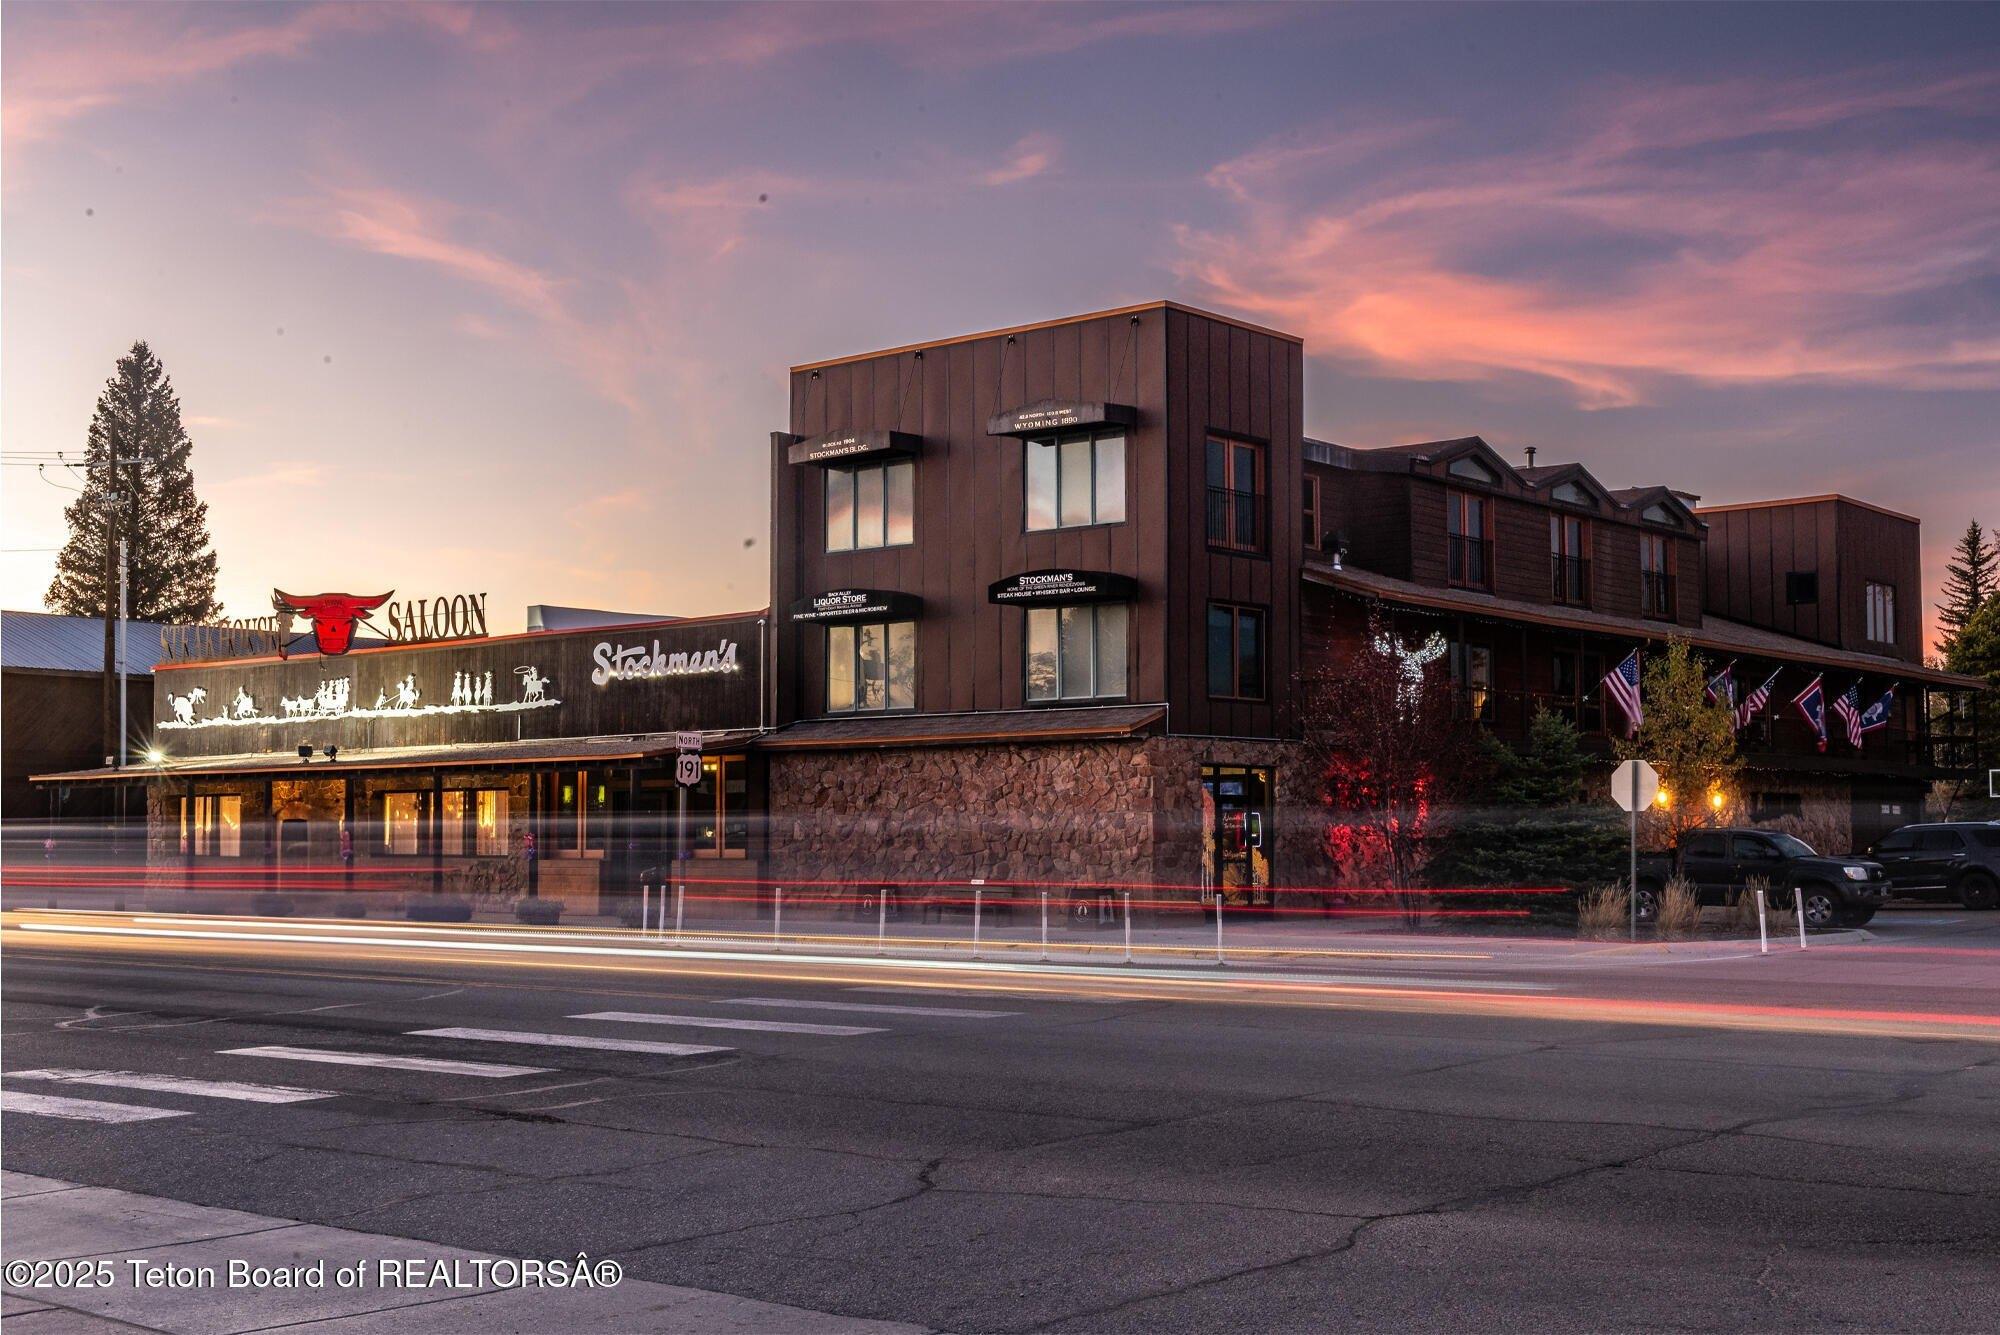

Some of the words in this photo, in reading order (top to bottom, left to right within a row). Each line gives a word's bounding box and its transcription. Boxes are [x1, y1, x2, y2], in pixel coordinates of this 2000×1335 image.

[1014, 418, 1058, 430] WYOMING
[1061, 416, 1078, 424] 1890
[809, 446, 849, 460] STOCKMAN'S
[1019, 573, 1073, 585] STOCKMAN'S
[996, 591, 1014, 599] STEAK
[1014, 590, 1032, 598] HOUSE
[1035, 588, 1059, 596] WHISKEY
[1059, 587, 1071, 595] BAR
[1073, 585, 1097, 593] LOUNGE
[813, 597, 841, 607] LIQUOR
[842, 593, 867, 604] STORE
[387, 592, 488, 640] SALOON
[819, 609, 843, 617] IMPORTED
[678, 735, 700, 746] NORTH
[679, 760, 699, 779] 191
